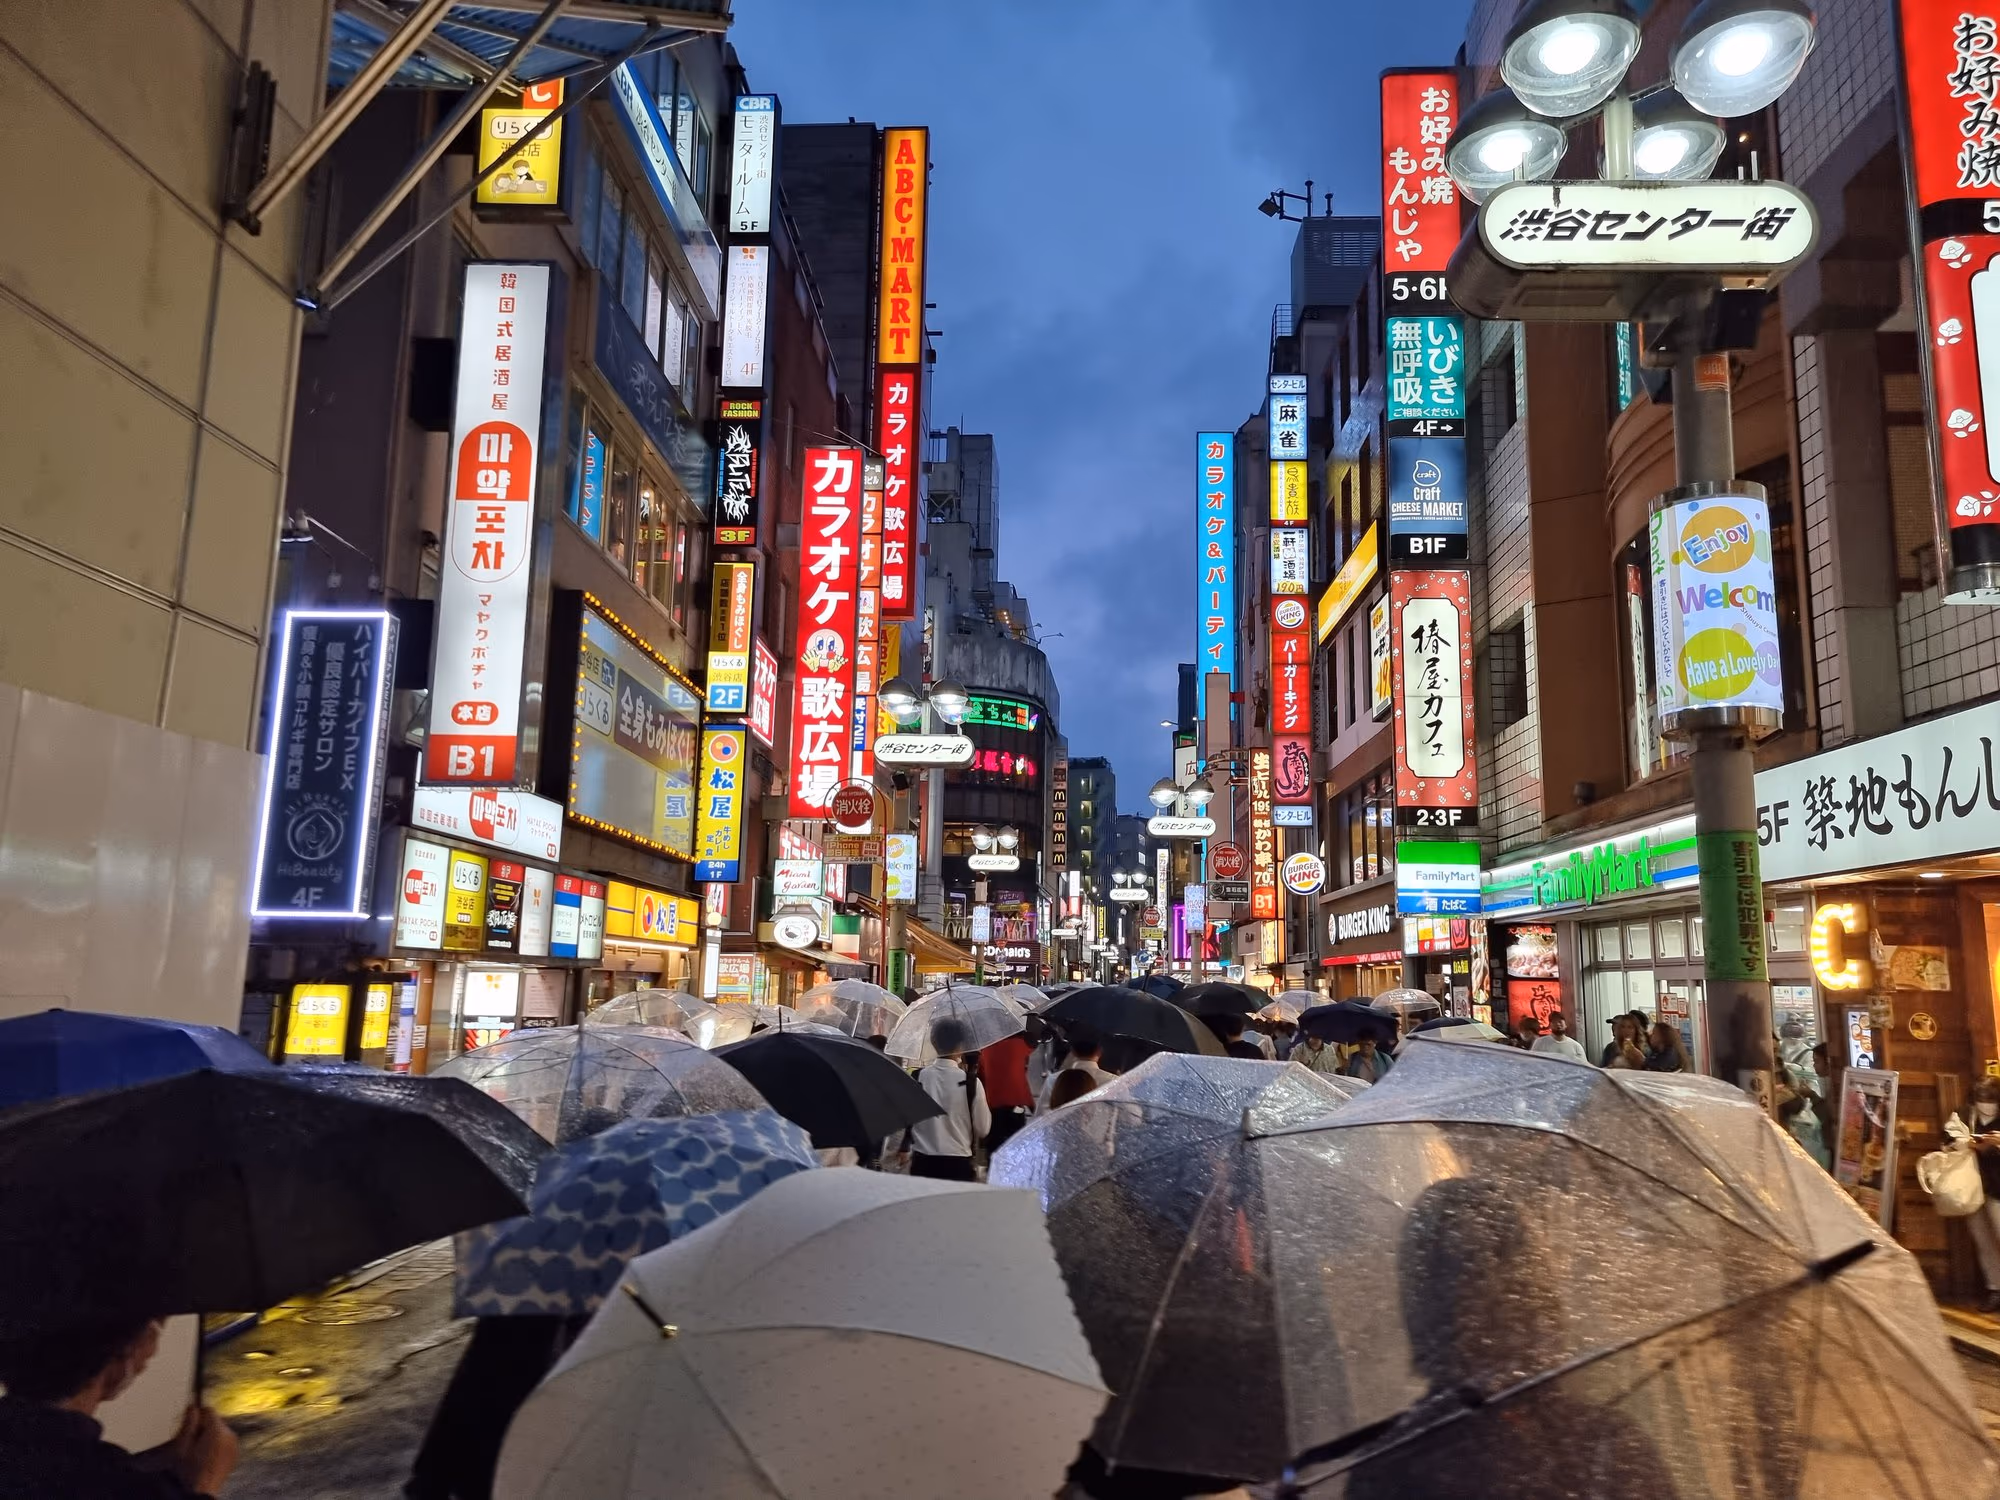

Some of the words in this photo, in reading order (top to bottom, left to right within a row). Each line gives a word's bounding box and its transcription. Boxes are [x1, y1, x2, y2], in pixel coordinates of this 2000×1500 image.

[739, 98, 771, 110] CBR
[756, 114, 769, 179] 渋谷センター街
[1420, 86, 1454, 205] お好み焼
[735, 115, 755, 215] モニタールーム
[1388, 147, 1423, 262] もんじゃ
[740, 221, 758, 231] 5F
[1499, 207, 1797, 241] 渋谷センター街
[491, 273, 517, 411] 韓国式居酒屋
[740, 362, 759, 376] 4F
[1392, 320, 1423, 406] 無呼吸
[1428, 320, 1460, 404] いびき
[1270, 380, 1306, 389] センタービル
[723, 409, 758, 417] FASHION
[730, 402, 753, 410] ROCK
[1393, 407, 1459, 418] ご相談ください
[1279, 404, 1298, 448] 麻雀
[1413, 420, 1438, 436] 4F
[471, 433, 514, 570] 마약포차
[881, 382, 909, 600] カラオケ歌広場
[1413, 486, 1441, 502] Craft
[1391, 502, 1422, 514] CHEESE
[1423, 502, 1463, 517] MARKET
[719, 531, 750, 542] 3F
[806, 451, 853, 625] カラオケ
[1409, 538, 1447, 554] B1F
[1683, 522, 1749, 566] Enjoy
[1676, 582, 1776, 615] Welcom
[733, 570, 749, 650] 全身もみほぐし
[1280, 611, 1301, 623] KING
[1740, 607, 1763, 630] Shibuya
[470, 594, 492, 690] マヤクポチャ
[714, 656, 743, 666] りらくる
[1685, 655, 1719, 688] Have
[1719, 662, 1728, 679] a
[1728, 650, 1766, 678] Lovely
[712, 672, 743, 682] 渋谷店
[1283, 639, 1298, 729] バーガーキング
[1411, 618, 1452, 757] 椿屋カフェ
[714, 688, 739, 705] 2F
[457, 704, 492, 722] 本店
[620, 685, 694, 772] 全身もみほぐし
[797, 677, 845, 809] 歌広場
[879, 743, 968, 755] 渋谷センター街
[448, 745, 495, 777] B1
[1253, 752, 1270, 799] 生ビール
[709, 767, 735, 819] 松屋
[472, 796, 518, 831] 마약포차
[836, 798, 871, 815] 消火栓
[1274, 810, 1311, 821] センタービル
[1757, 800, 1789, 846] 5F
[706, 835, 715, 856] 定食
[715, 830, 723, 853] カレー
[723, 827, 731, 849] 牛めし
[1254, 829, 1273, 867] かわ串
[708, 861, 725, 869] 24h
[1215, 856, 1241, 868] 消火栓
[1287, 862, 1320, 875] BURGER
[1532, 836, 1654, 905] FamilyMart
[455, 869, 480, 887] りらくる
[710, 870, 722, 878] 1F
[1288, 870, 1321, 886] KING
[1415, 870, 1475, 883] FamilyMart
[291, 887, 324, 908] 4F
[406, 878, 437, 897] 마약포차
[1255, 894, 1273, 908] B1
[1425, 898, 1438, 911] 酒
[1442, 899, 1467, 911] たばこ
[656, 901, 677, 935] 松屋
[1338, 909, 1368, 940] BURGER
[1368, 904, 1390, 934] KING
